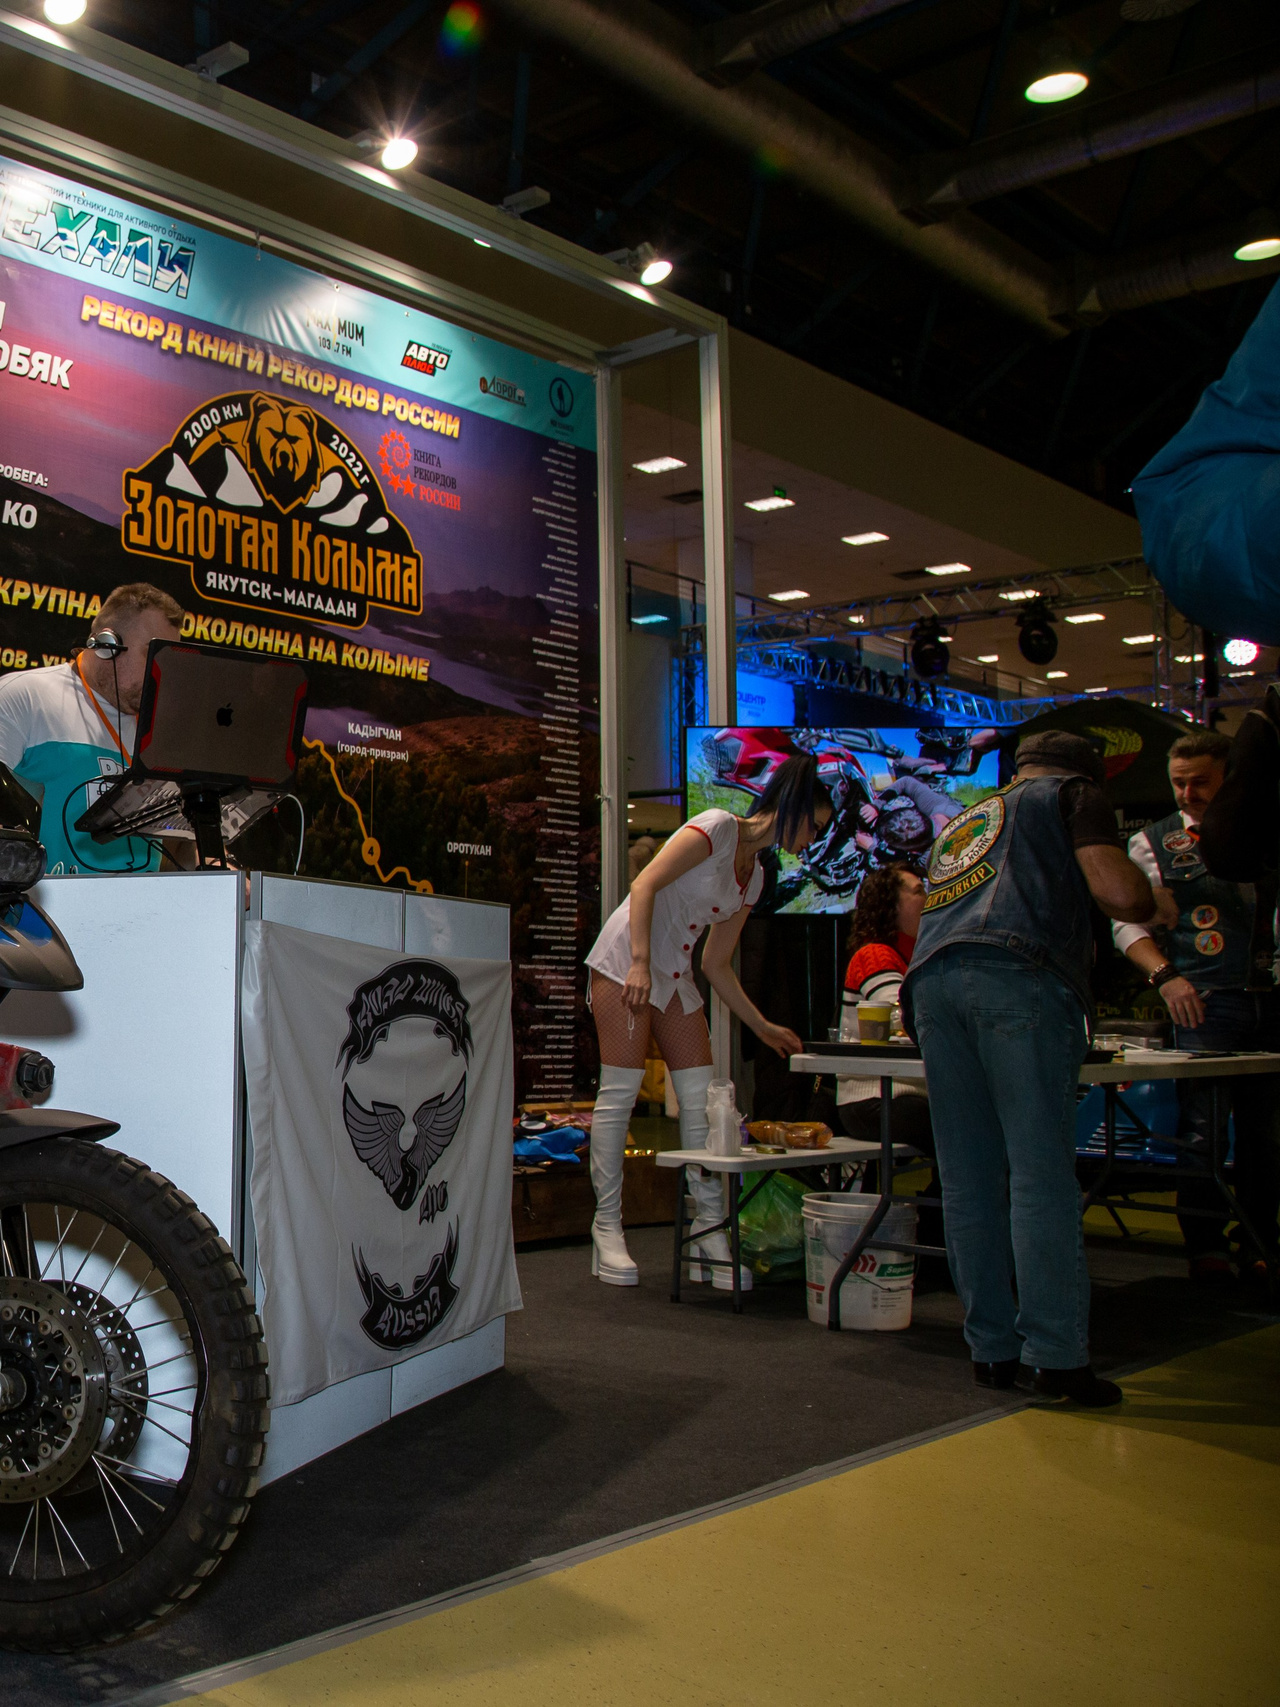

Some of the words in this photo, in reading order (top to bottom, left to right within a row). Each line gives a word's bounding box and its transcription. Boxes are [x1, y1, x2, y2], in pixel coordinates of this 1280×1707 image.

[73, 193, 107, 214] ТЕХНИКИ
[107, 206, 124, 220] ДЛЯ
[125, 213, 167, 236] АКТИВНОГО
[167, 228, 197, 247] ОТДЫХА
[80, 294, 184, 354] РЕКОРД
[186, 327, 265, 376] КНИГИ
[267, 353, 380, 414] РЕКОРДОВ
[381, 390, 462, 440] РОССИИ
[402, 355, 435, 375] ПЛЮС
[405, 342, 449, 369] АВТО
[182, 406, 222, 449] 2000
[223, 401, 244, 420] КМ
[328, 434, 364, 478] 2022
[412, 448, 442, 469] КНИГА
[412, 466, 458, 490] РЕКОРДОВ
[418, 484, 462, 511] РОССИИ
[1, 499, 38, 530] КО
[179, 611, 305, 659] ОКОЛОННА
[308, 635, 339, 665] НА
[340, 642, 431, 683] КОЛЫМЕ
[347, 721, 402, 742] КАДЫГЧАН
[336, 740, 410, 763] (город-призрак)
[446, 841, 492, 857] ОРОТУКАН
[924, 867, 986, 908] ЫКТЫВКАР
[356, 973, 415, 1031] ROAD
[372, 1285, 442, 1341] RUSSIA
